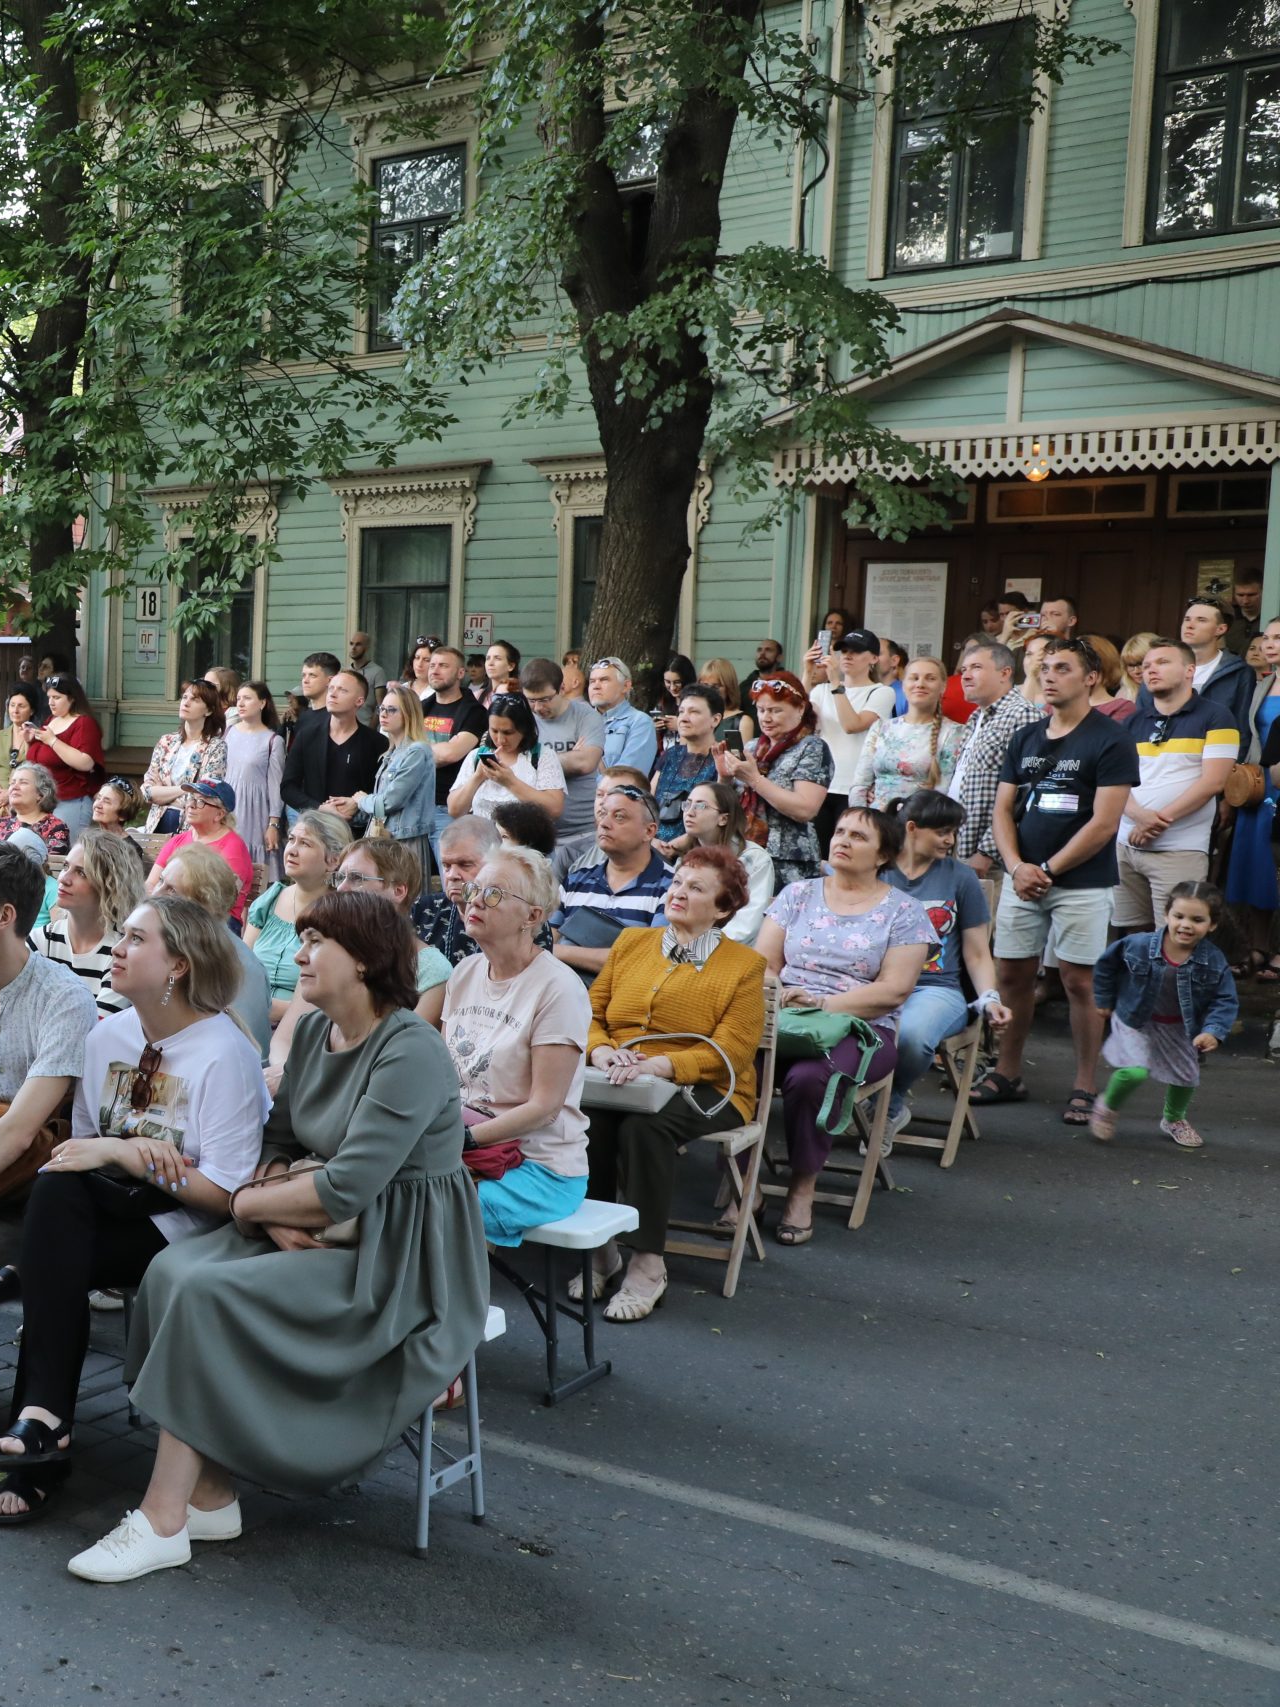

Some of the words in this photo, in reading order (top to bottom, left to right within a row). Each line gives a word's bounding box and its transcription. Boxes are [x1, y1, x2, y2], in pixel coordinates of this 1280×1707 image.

[141, 590, 157, 616] 18
[470, 617, 487, 628] ПГ
[141, 633, 153, 645] ПГ
[1021, 756, 1081, 772] UNKOWN
